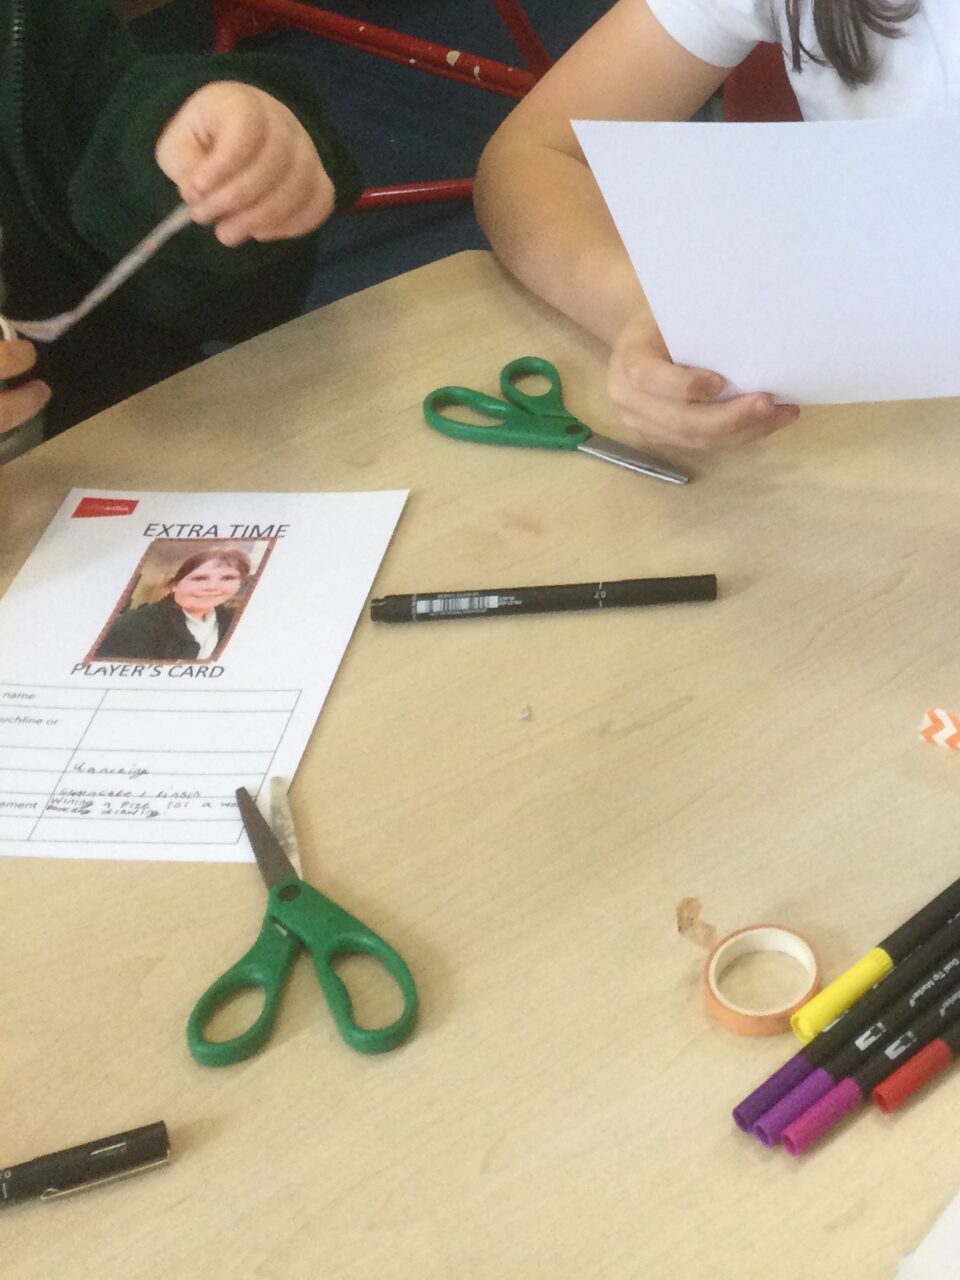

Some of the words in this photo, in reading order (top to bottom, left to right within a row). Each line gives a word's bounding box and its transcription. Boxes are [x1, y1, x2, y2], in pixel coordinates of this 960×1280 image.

[143, 523, 219, 538] EXTRA
[229, 524, 291, 539] TIME
[70, 663, 163, 679] PLAYER'S
[167, 665, 225, 679] CARD
[2, 692, 37, 701] name
[942, 957, 960, 973] Dual
[930, 969, 946, 983] Tip
[911, 978, 936, 1006] Marker
